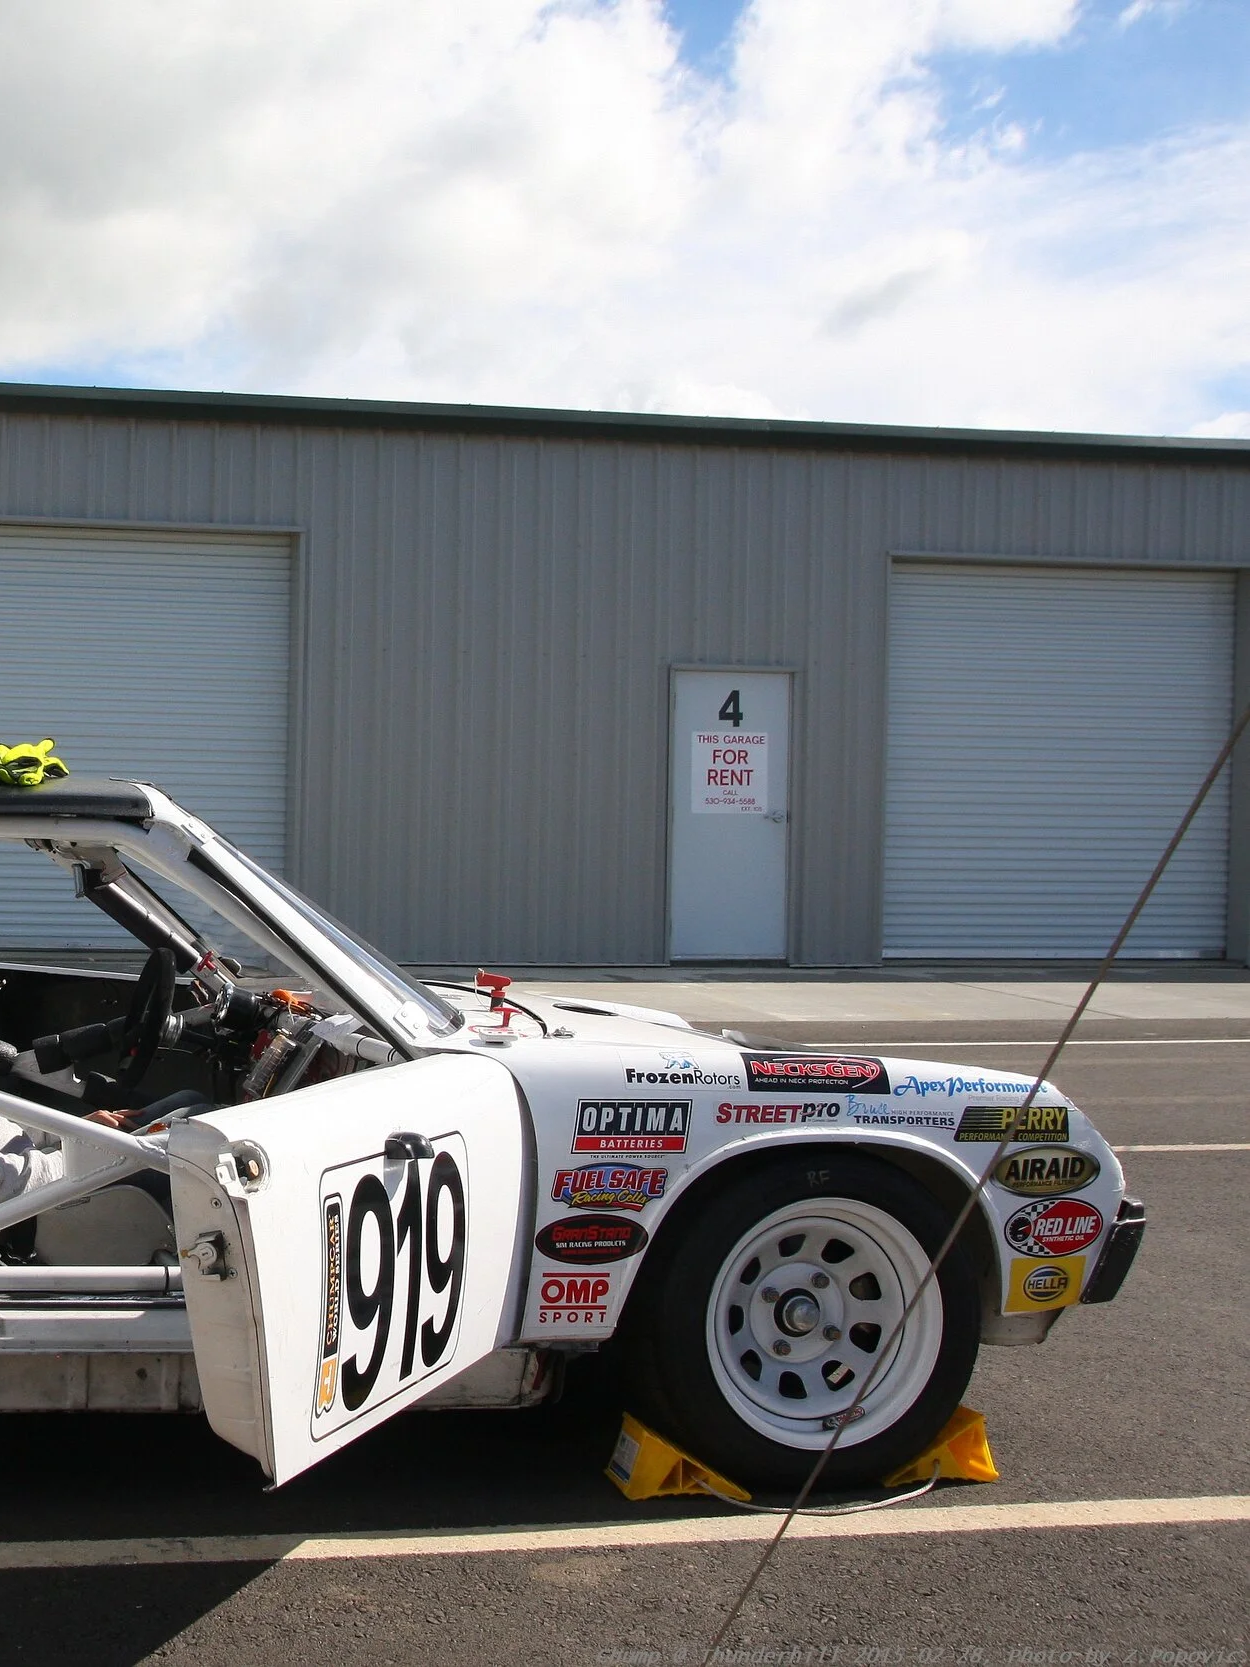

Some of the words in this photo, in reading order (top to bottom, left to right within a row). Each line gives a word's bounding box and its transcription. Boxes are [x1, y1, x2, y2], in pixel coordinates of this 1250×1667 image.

[719, 690, 743, 727] 4
[697, 735, 719, 743] THIS
[724, 735, 765, 744] GARAGE
[712, 749, 748, 764] FOR
[707, 769, 753, 786] RENT
[893, 1075, 945, 1097] Apex
[582, 1106, 683, 1131] OPTIMA
[854, 1115, 955, 1126] TRANSPORTERS
[600, 1139, 663, 1148] BATTERIES
[1018, 1132, 1067, 1141] COMPETITION
[1005, 1157, 1085, 1180] AIRAID
[552, 1169, 606, 1200] FUEL
[609, 1168, 667, 1197] SAFE
[571, 1190, 617, 1206] Racing
[617, 1189, 648, 1204] Cells
[1034, 1217, 1063, 1236] RED
[1065, 1215, 1097, 1235] LINE
[326, 1213, 336, 1345] CHUMPCAR
[341, 1150, 466, 1412] 919
[1028, 1276, 1068, 1289] HELLA
[541, 1279, 609, 1304] OMP
[331, 1279, 339, 1342] WORLD
[539, 1311, 606, 1323] SPORT
